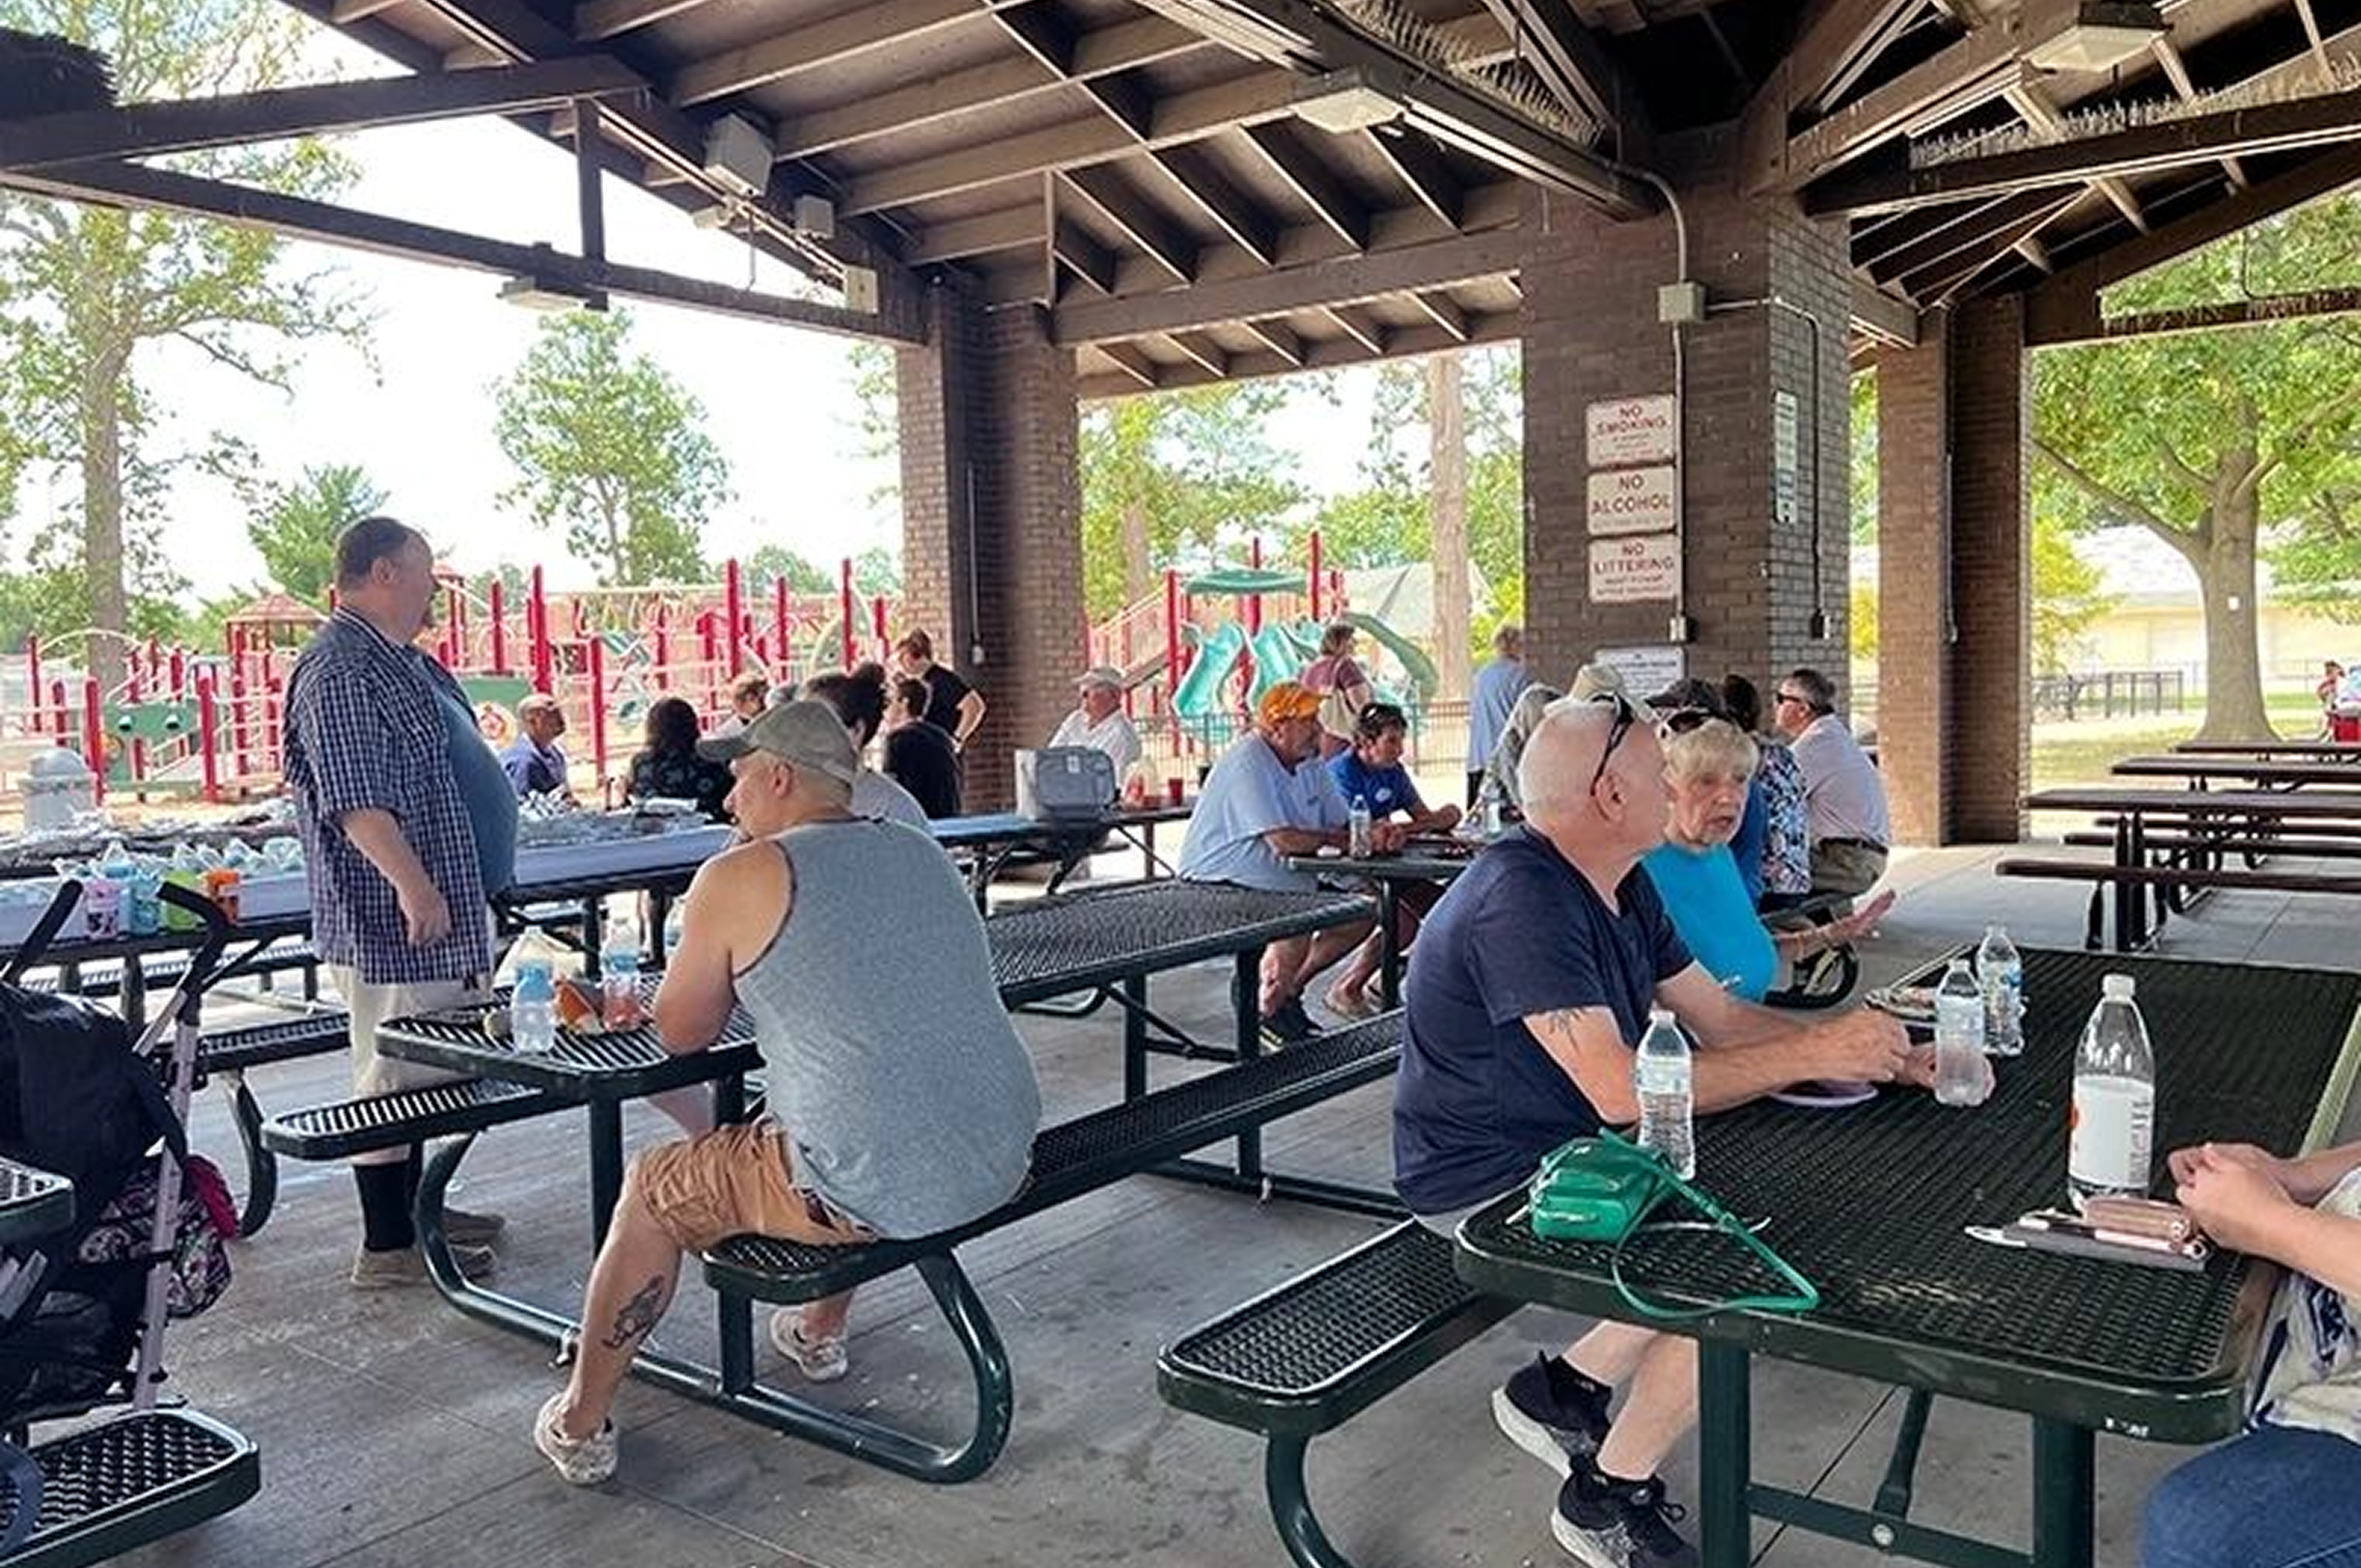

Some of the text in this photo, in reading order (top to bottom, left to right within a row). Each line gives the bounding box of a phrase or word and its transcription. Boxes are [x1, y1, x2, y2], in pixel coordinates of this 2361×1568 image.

[1619, 404, 1643, 418] NO
[1596, 415, 1667, 436] SMOKING
[1619, 474, 1644, 491] NO
[1592, 493, 1670, 515] ALCOHOL
[1621, 541, 1645, 555] NO
[1594, 555, 1675, 575] LITTERING
